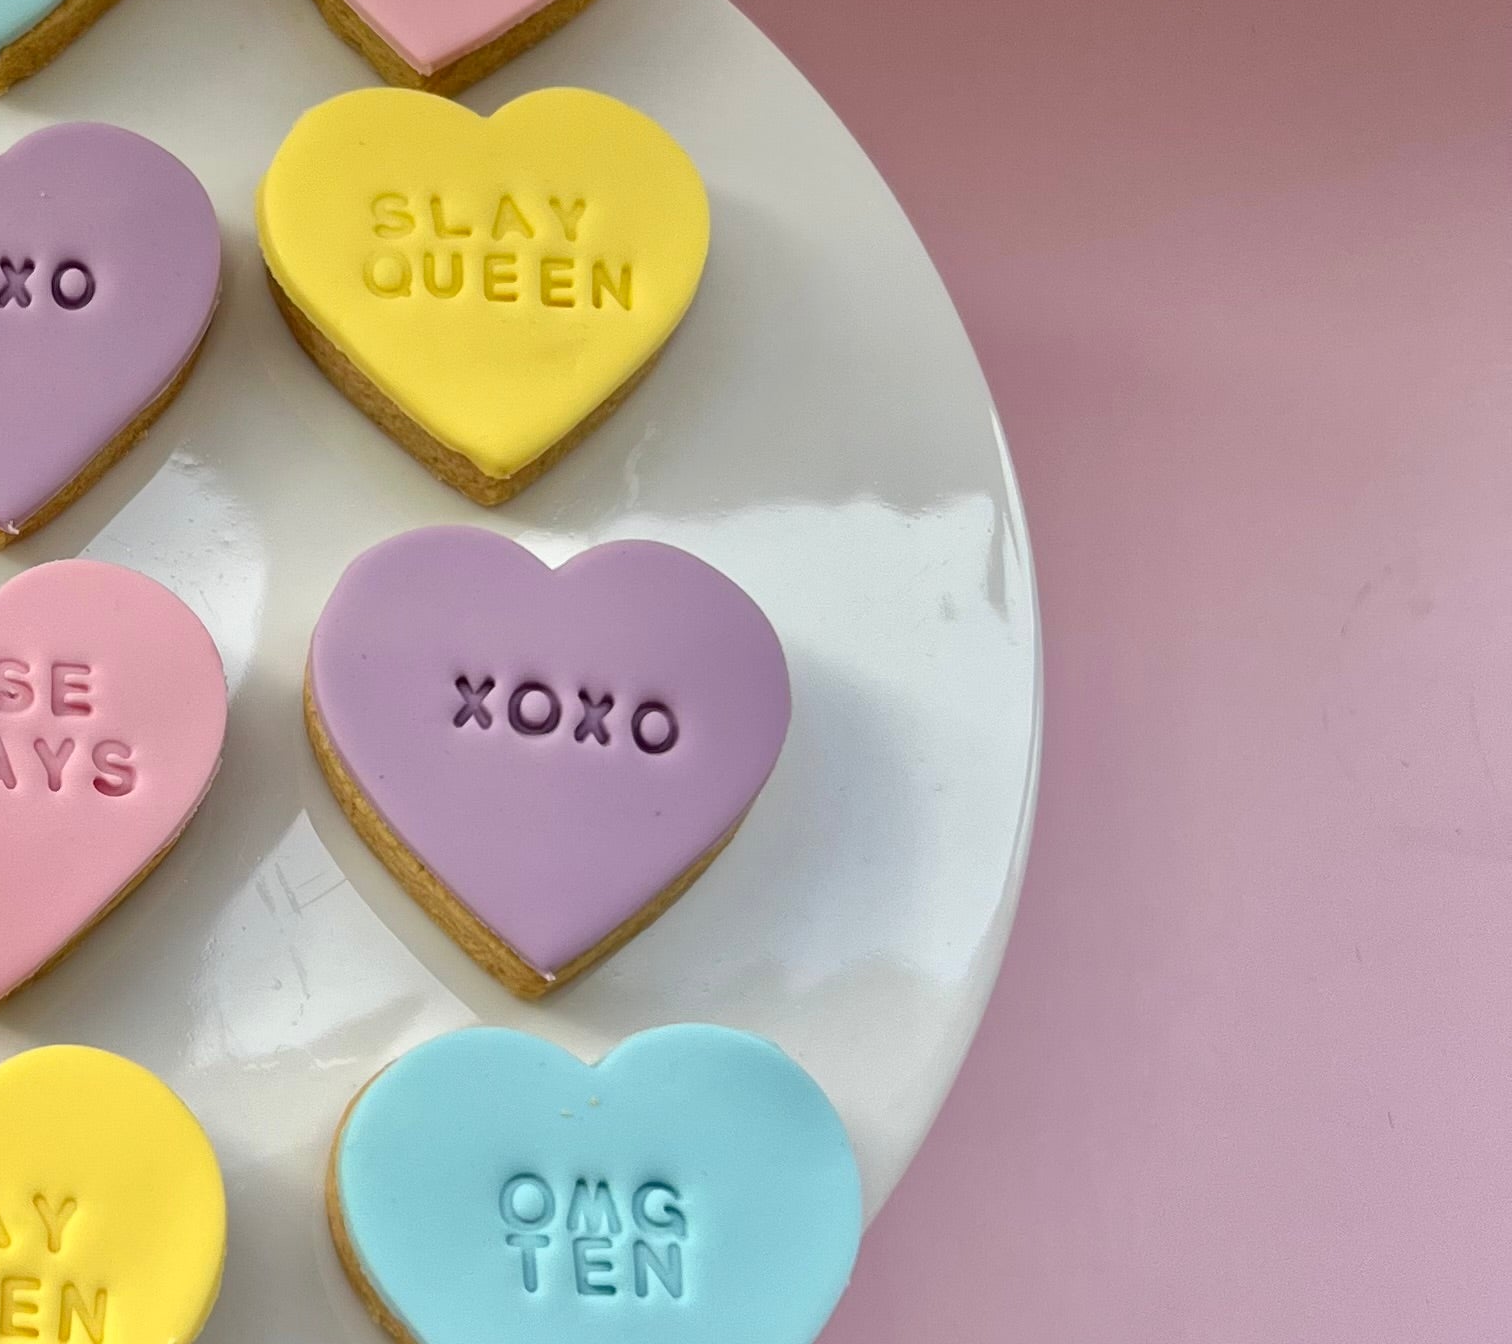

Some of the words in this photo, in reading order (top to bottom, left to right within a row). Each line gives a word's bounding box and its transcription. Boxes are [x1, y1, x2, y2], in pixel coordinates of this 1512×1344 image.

[371, 193, 586, 242] SLAY
[363, 252, 632, 311] QUEEN
[453, 673, 681, 756] XOXO
[499, 1173, 688, 1236] OMG
[507, 1233, 684, 1299] TEN
